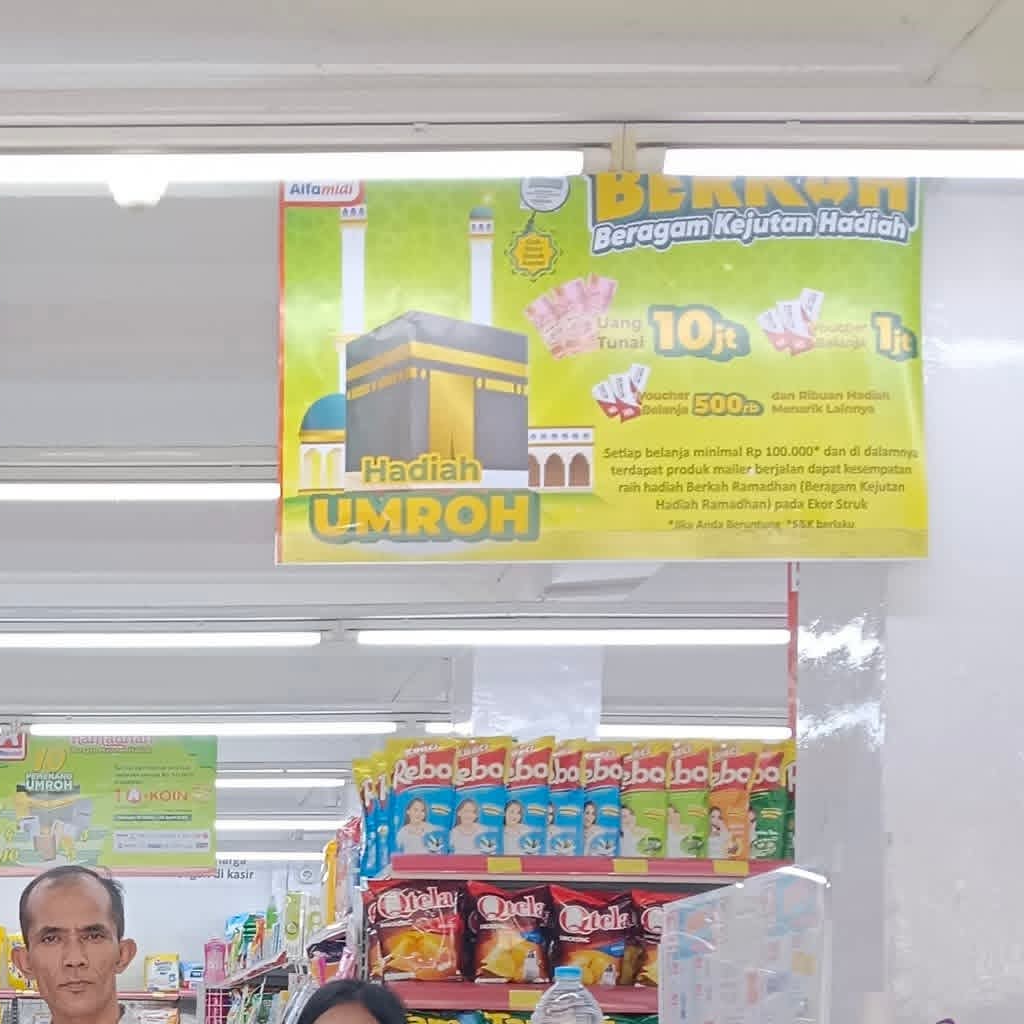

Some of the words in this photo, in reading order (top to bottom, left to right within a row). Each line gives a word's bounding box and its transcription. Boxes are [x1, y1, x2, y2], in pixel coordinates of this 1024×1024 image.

[289, 183, 353, 196] Alfamidi
[593, 216, 710, 251] Beragam
[714, 211, 814, 243] Kejutan
[818, 210, 908, 241] Hadiah
[603, 447, 642, 461] Setiap
[645, 446, 690, 460] belanja
[694, 446, 743, 457] minimal
[746, 446, 762, 461] Rp
[824, 446, 846, 457] dan
[850, 446, 861, 457] di
[363, 458, 481, 483] Hadiah
[611, 465, 663, 478] terdapat
[666, 464, 710, 477] produk
[756, 464, 805, 477] berjalan
[808, 464, 840, 476] dapat
[643, 481, 684, 493] hadiah
[687, 481, 729, 493] Berkah
[732, 481, 797, 493] Ramadhan
[800, 480, 856, 495] (Beragam
[860, 481, 906, 494] Kejutan
[656, 498, 699, 510] Hadiah
[703, 498, 772, 513] Ramadhan)
[775, 499, 804, 512] pada
[807, 499, 833, 510] Ekor
[836, 499, 868, 511] Struk
[314, 495, 530, 537] UMROH
[455, 756, 504, 784] ebo
[26, 780, 73, 792] UMROH
[226, 869, 254, 880] kasir
[377, 887, 453, 920] Qtela
